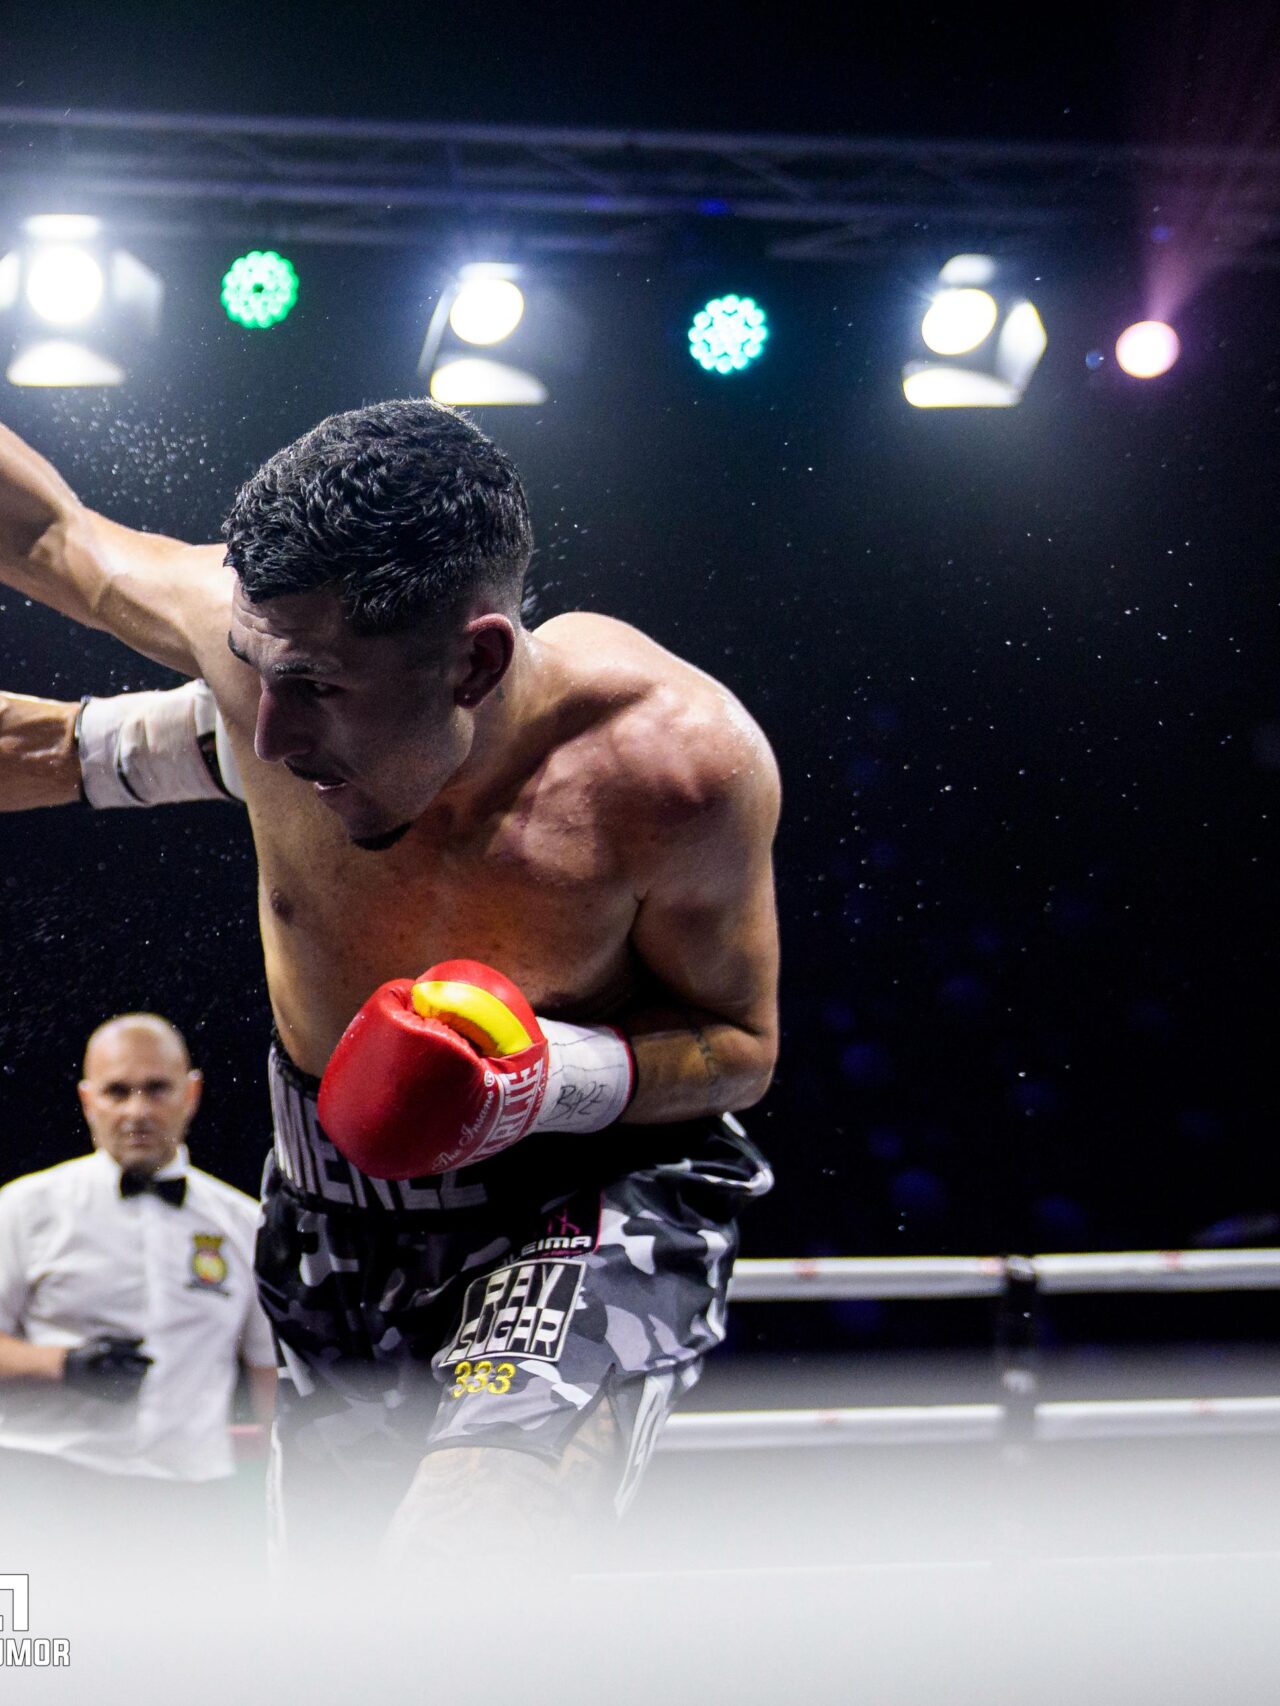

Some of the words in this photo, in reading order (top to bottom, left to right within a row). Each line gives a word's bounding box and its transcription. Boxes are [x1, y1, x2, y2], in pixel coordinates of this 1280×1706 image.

[483, 1263, 566, 1311] RAY
[446, 1305, 566, 1362] SUGAR
[450, 1360, 516, 1398] 333
